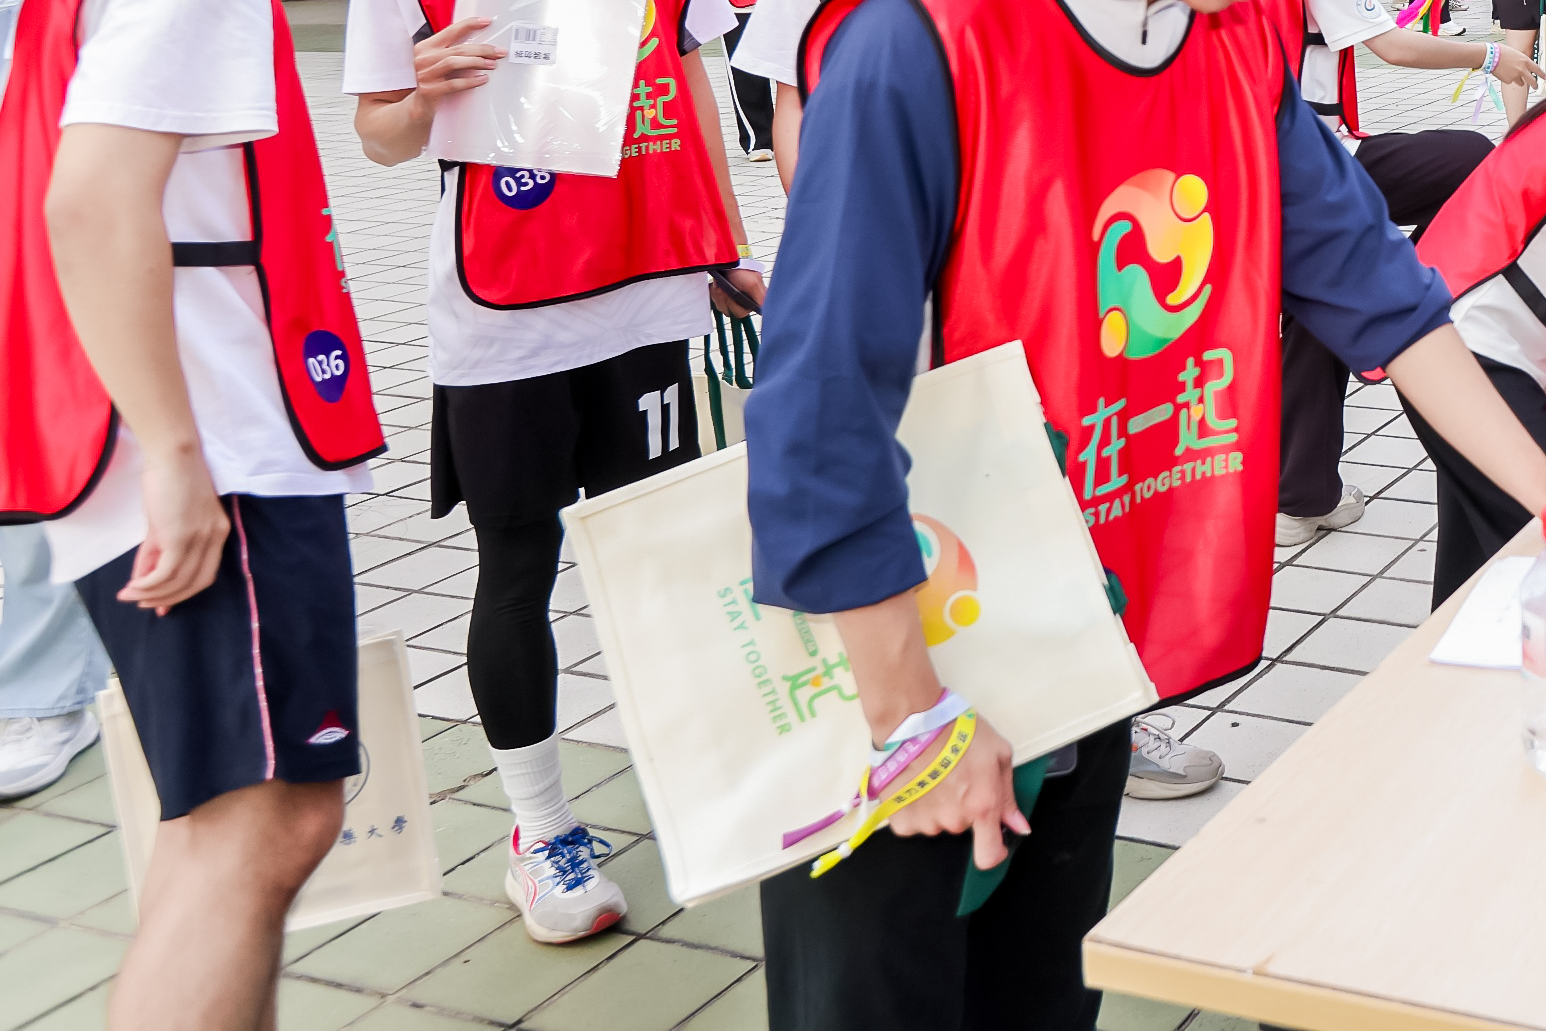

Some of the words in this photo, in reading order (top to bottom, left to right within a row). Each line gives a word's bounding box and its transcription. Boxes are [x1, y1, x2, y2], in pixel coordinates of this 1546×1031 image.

[500, 168, 551, 197] 038
[622, 138, 681, 159] GETHER
[306, 350, 345, 382] 036
[637, 382, 679, 460] 11
[1078, 347, 1238, 500] 在一起
[1083, 491, 1132, 528] STAY
[1134, 451, 1244, 504] TOGETHER
[717, 587, 749, 631] STAY
[741, 638, 793, 736] TOGETHER
